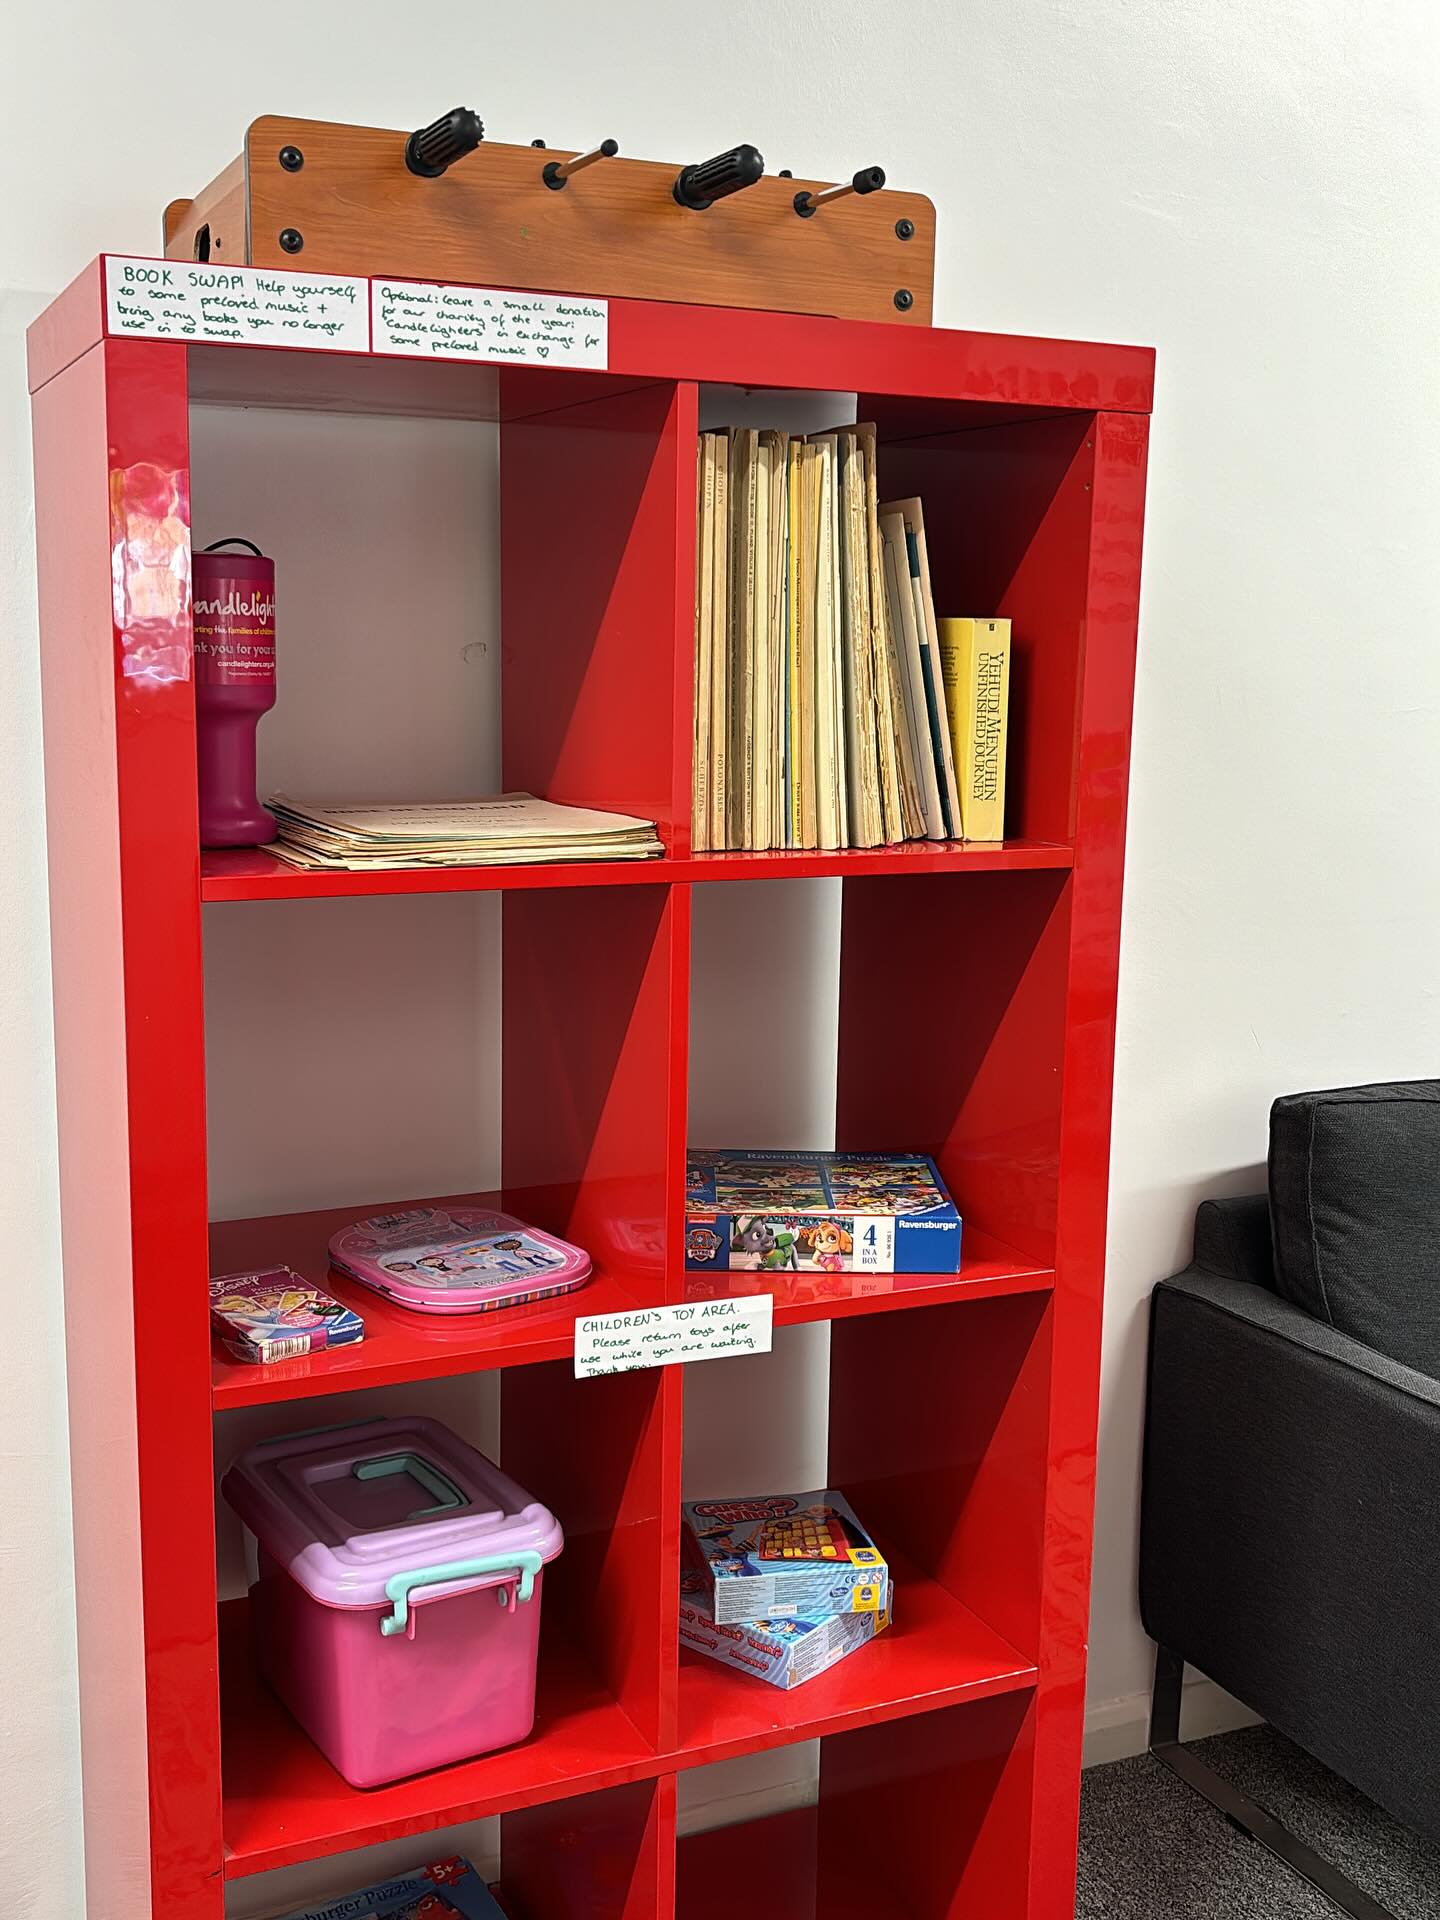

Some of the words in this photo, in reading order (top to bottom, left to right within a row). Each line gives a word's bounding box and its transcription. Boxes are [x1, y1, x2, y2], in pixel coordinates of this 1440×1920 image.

[124, 266, 173, 286] BOOK
[256, 278, 286, 296] Help
[292, 285, 356, 304] yourself
[118, 286, 135, 296] to
[148, 289, 186, 301] some
[201, 296, 259, 310] preloved
[265, 301, 309, 313] music
[317, 303, 328, 314] +
[381, 287, 438, 305] Optional:
[442, 294, 473, 307] leave
[483, 299, 492, 307] a
[503, 300, 545, 312] small
[556, 303, 606, 318] donation
[117, 300, 154, 321] bring
[163, 310, 196, 326] any
[203, 310, 238, 323] books
[247, 317, 274, 329] you
[303, 319, 344, 336] longer
[121, 320, 145, 329] use
[158, 322, 171, 332] in
[181, 325, 196, 334] to
[382, 305, 396, 318] for
[402, 308, 425, 316] our
[436, 310, 485, 328] charity
[491, 313, 505, 327] of
[512, 314, 530, 324] the
[390, 335, 421, 346] some
[432, 340, 479, 352] preloved
[488, 346, 526, 355] music
[497, 327, 509, 337] in
[516, 330, 575, 349] exchange
[585, 334, 600, 348] for
[210, 644, 234, 657] you
[237, 643, 252, 654] for
[987, 652, 1004, 714] YEHUDI
[976, 652, 990, 738] UNFINISHED
[973, 738, 986, 802] JOURNEY
[984, 718, 1002, 802] MENUHIN
[863, 1224, 877, 1246] 4
[898, 1220, 958, 1231] Ravensburger
[862, 1248, 871, 1256] IN
[872, 1248, 878, 1256] A
[672, 1307, 695, 1321] TOY
[592, 1338, 631, 1348] Please
[641, 1332, 682, 1343] return
[689, 1327, 715, 1337] toys
[722, 1322, 751, 1335] after
[580, 1355, 601, 1364] use
[612, 1350, 642, 1360] while
[652, 1347, 674, 1359] you
[681, 1342, 704, 1352] are
[695, 1500, 771, 1517] Guess
[432, 1864, 455, 1879] 5+
[302, 1897, 361, 1920] burger
[364, 1878, 419, 1906] Puzzle
